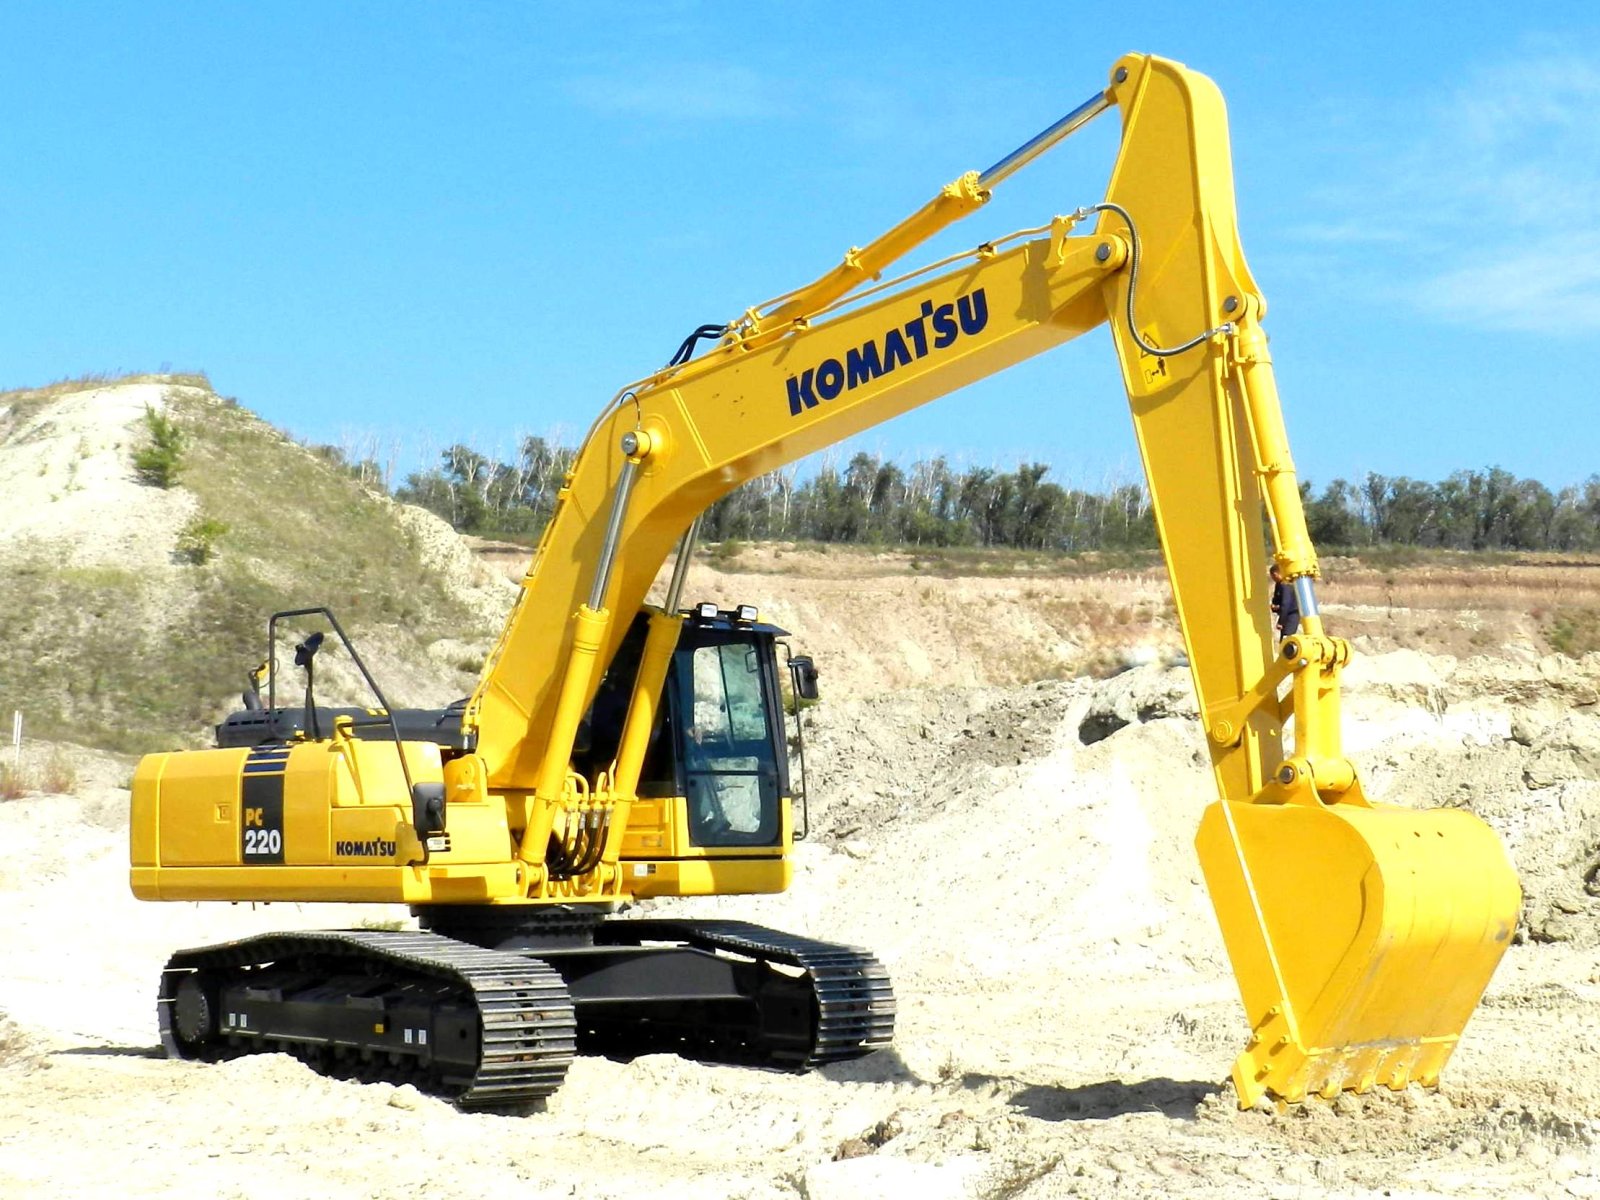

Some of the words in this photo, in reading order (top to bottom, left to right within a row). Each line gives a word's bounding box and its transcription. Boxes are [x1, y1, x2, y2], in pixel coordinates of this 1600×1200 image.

[786, 288, 988, 416] KOMATSU
[245, 808, 263, 826] PC
[245, 829, 281, 854] 220
[336, 837, 396, 857] KOMATSU
